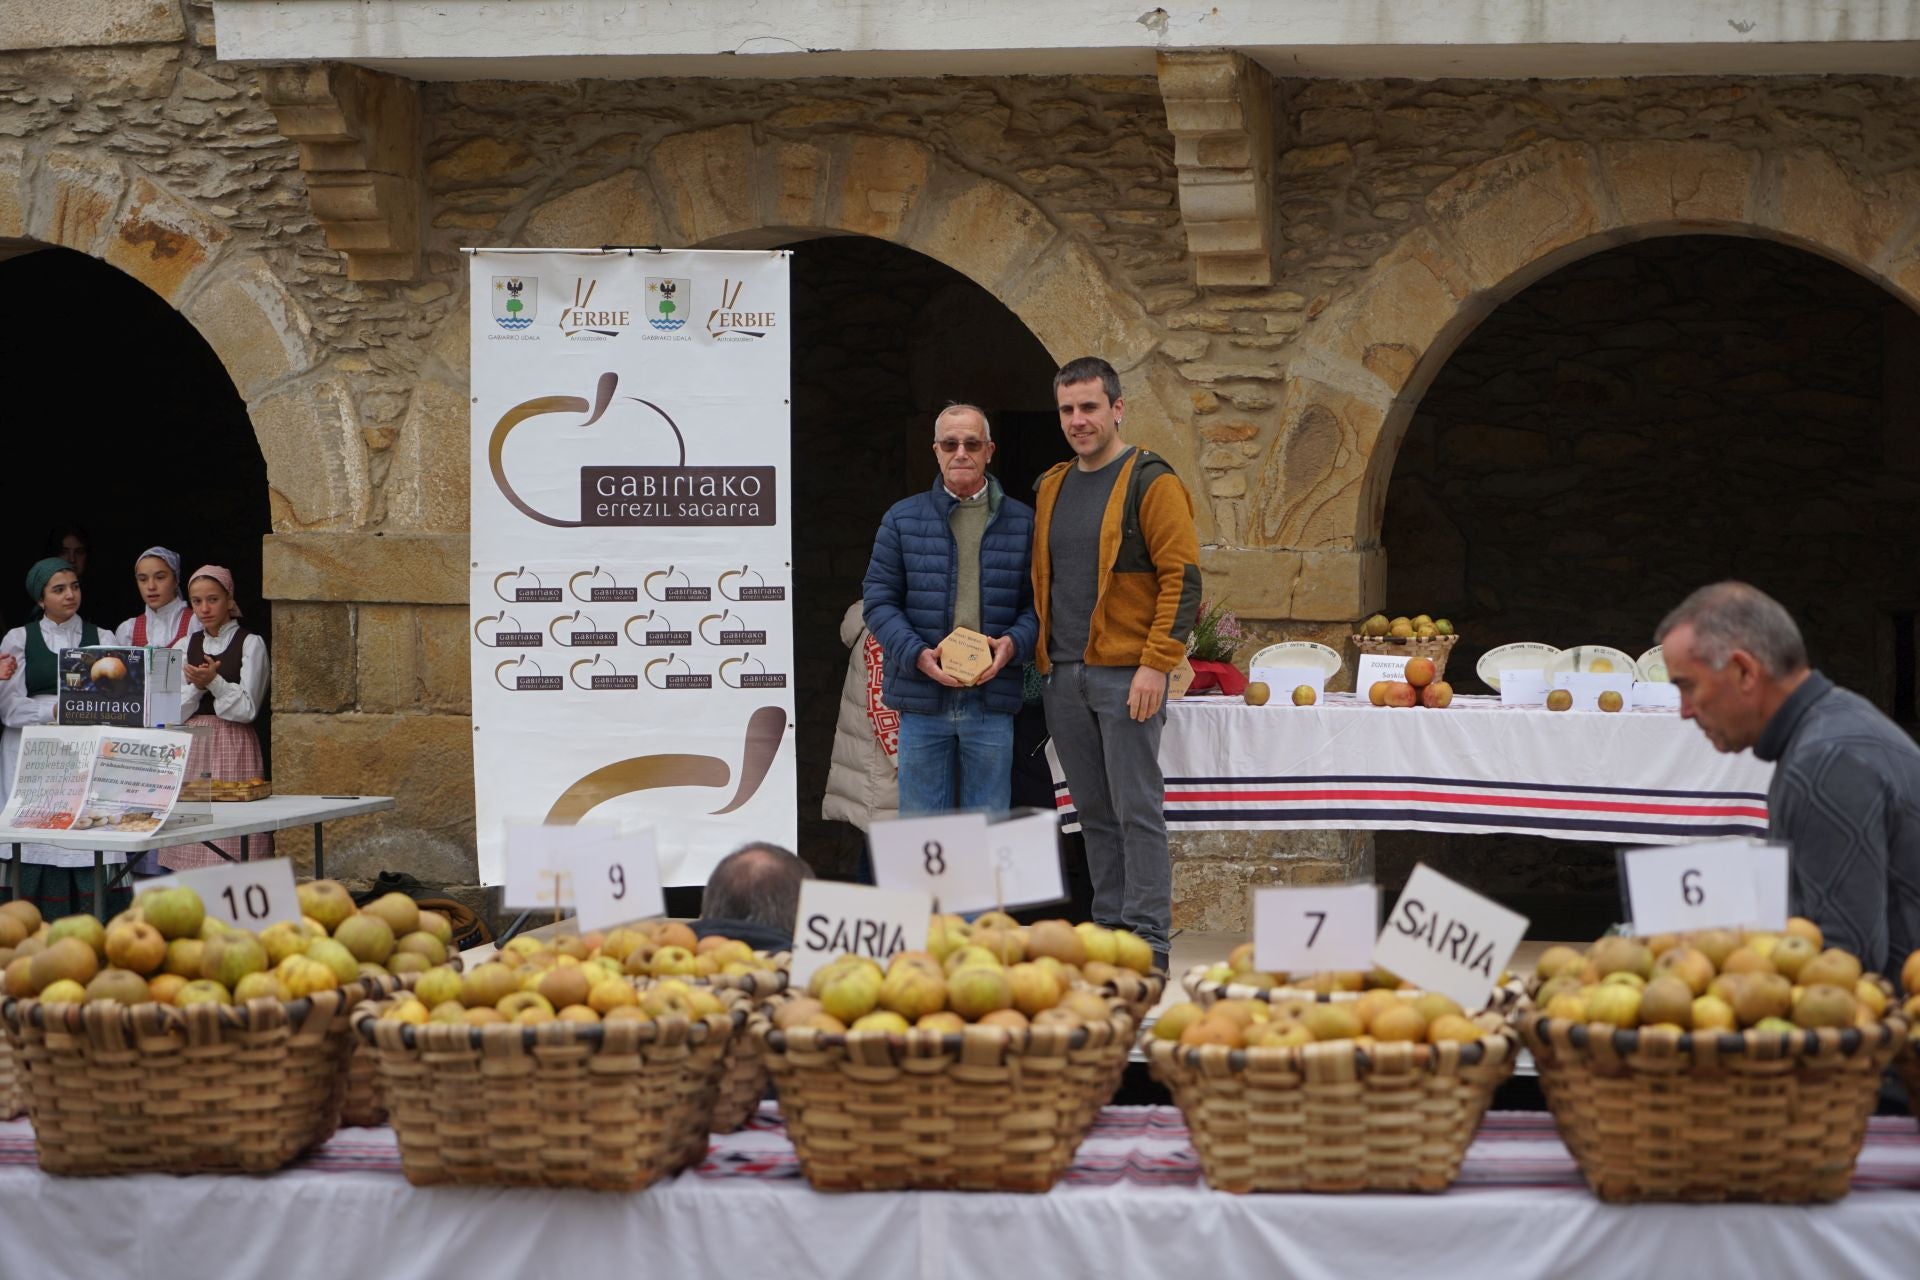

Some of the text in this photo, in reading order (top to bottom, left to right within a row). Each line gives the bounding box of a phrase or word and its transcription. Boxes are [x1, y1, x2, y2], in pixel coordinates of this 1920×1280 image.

[572, 312, 630, 327] ERBIE
[719, 312, 776, 327] ERBIE
[23, 740, 97, 756] SARTU HEMEN
[110, 741, 176, 760] ZOZKETA
[18, 775, 43, 784] eman
[922, 840, 947, 876] 8
[608, 863, 626, 900] 9
[1680, 869, 1704, 907] 6
[221, 883, 270, 921] 10
[805, 914, 906, 958] SARIA
[1303, 911, 1327, 948] 7
[1395, 897, 1495, 978] SARIA
